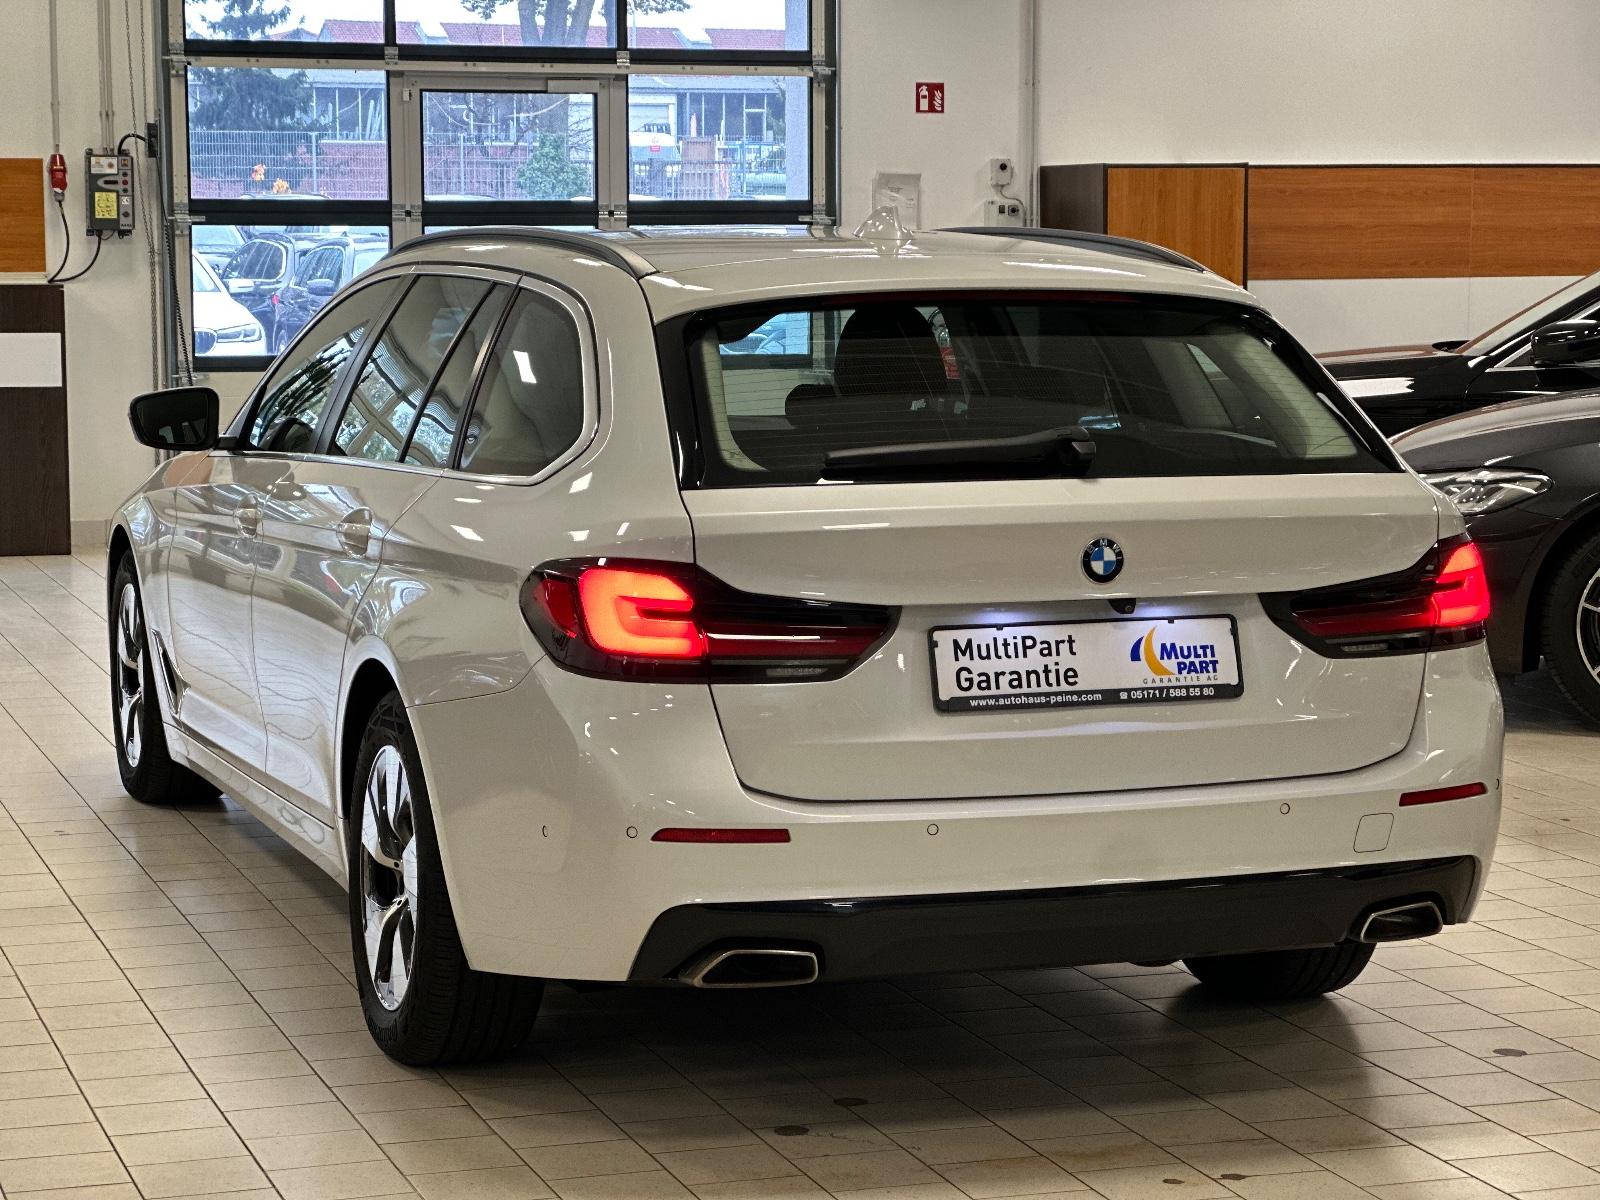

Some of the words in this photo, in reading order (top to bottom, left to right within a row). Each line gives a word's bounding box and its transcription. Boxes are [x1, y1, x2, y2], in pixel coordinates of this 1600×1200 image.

[1086, 538, 1121, 554] BMW
[952, 635, 1077, 661] MultiPart
[1159, 642, 1216, 660] MULTI
[1176, 659, 1219, 675] PART
[955, 661, 1079, 692] Garantie
[1142, 675, 1201, 685] GARANTIE
[969, 693, 1102, 707] www.autohaus-peine.com
[1130, 689, 1160, 699] 05171
[1169, 687, 1187, 697] 588
[1189, 687, 1201, 697] 55
[1202, 686, 1215, 696] 80
